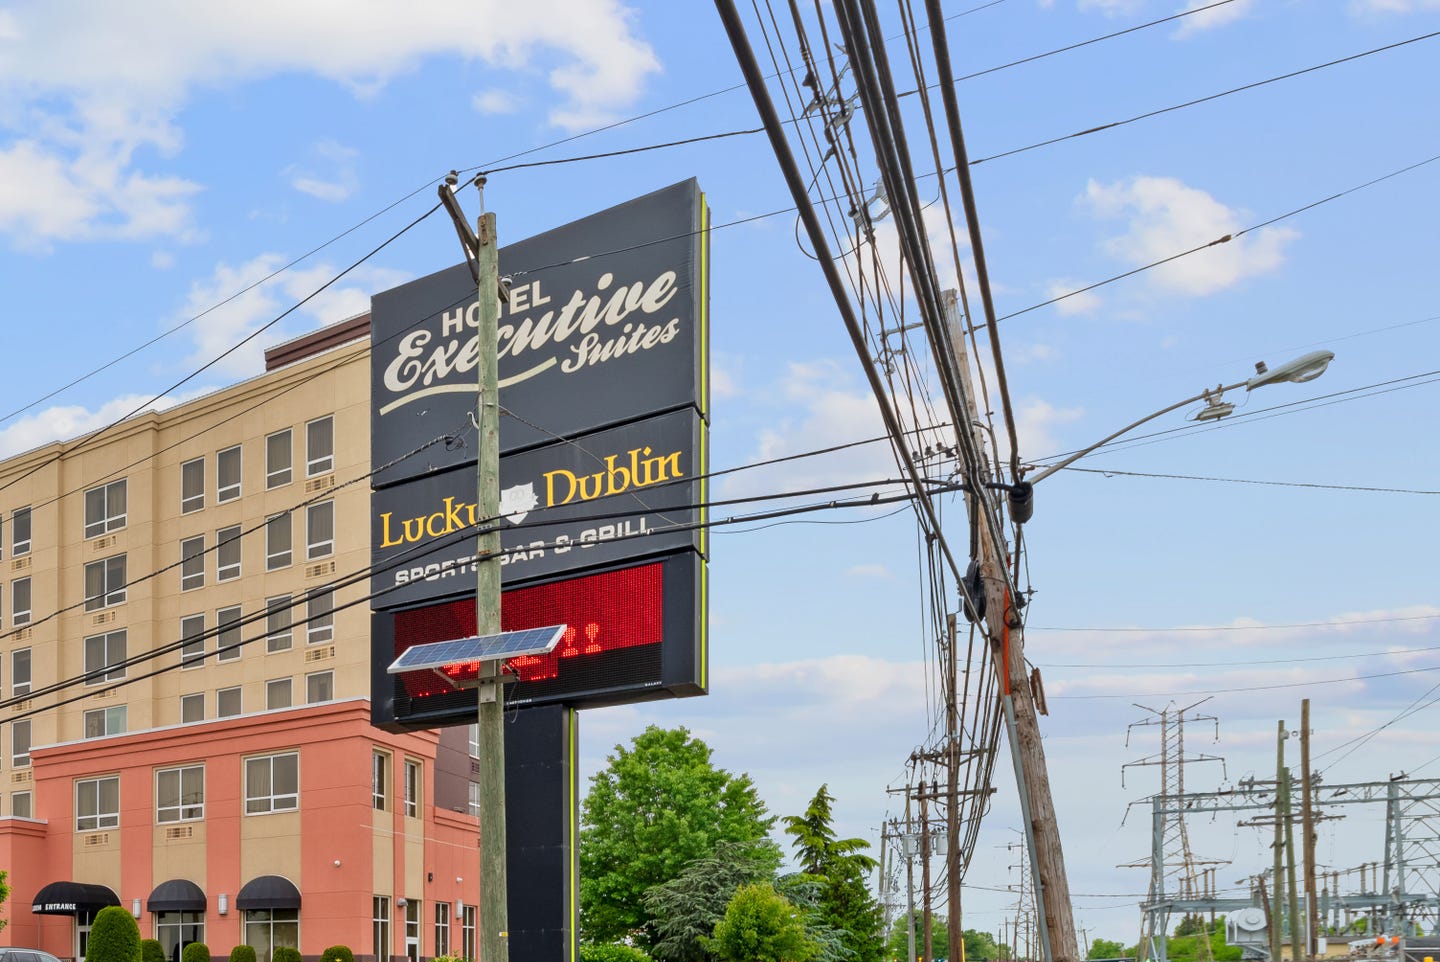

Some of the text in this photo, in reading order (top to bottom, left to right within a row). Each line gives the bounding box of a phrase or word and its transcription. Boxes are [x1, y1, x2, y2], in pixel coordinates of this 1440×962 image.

[383, 270, 678, 392] Executive
[561, 317, 679, 374] Suites
[543, 446, 684, 508] Dublin
[580, 516, 647, 549] GRILL
[45, 903, 77, 911] ENTRANCE
